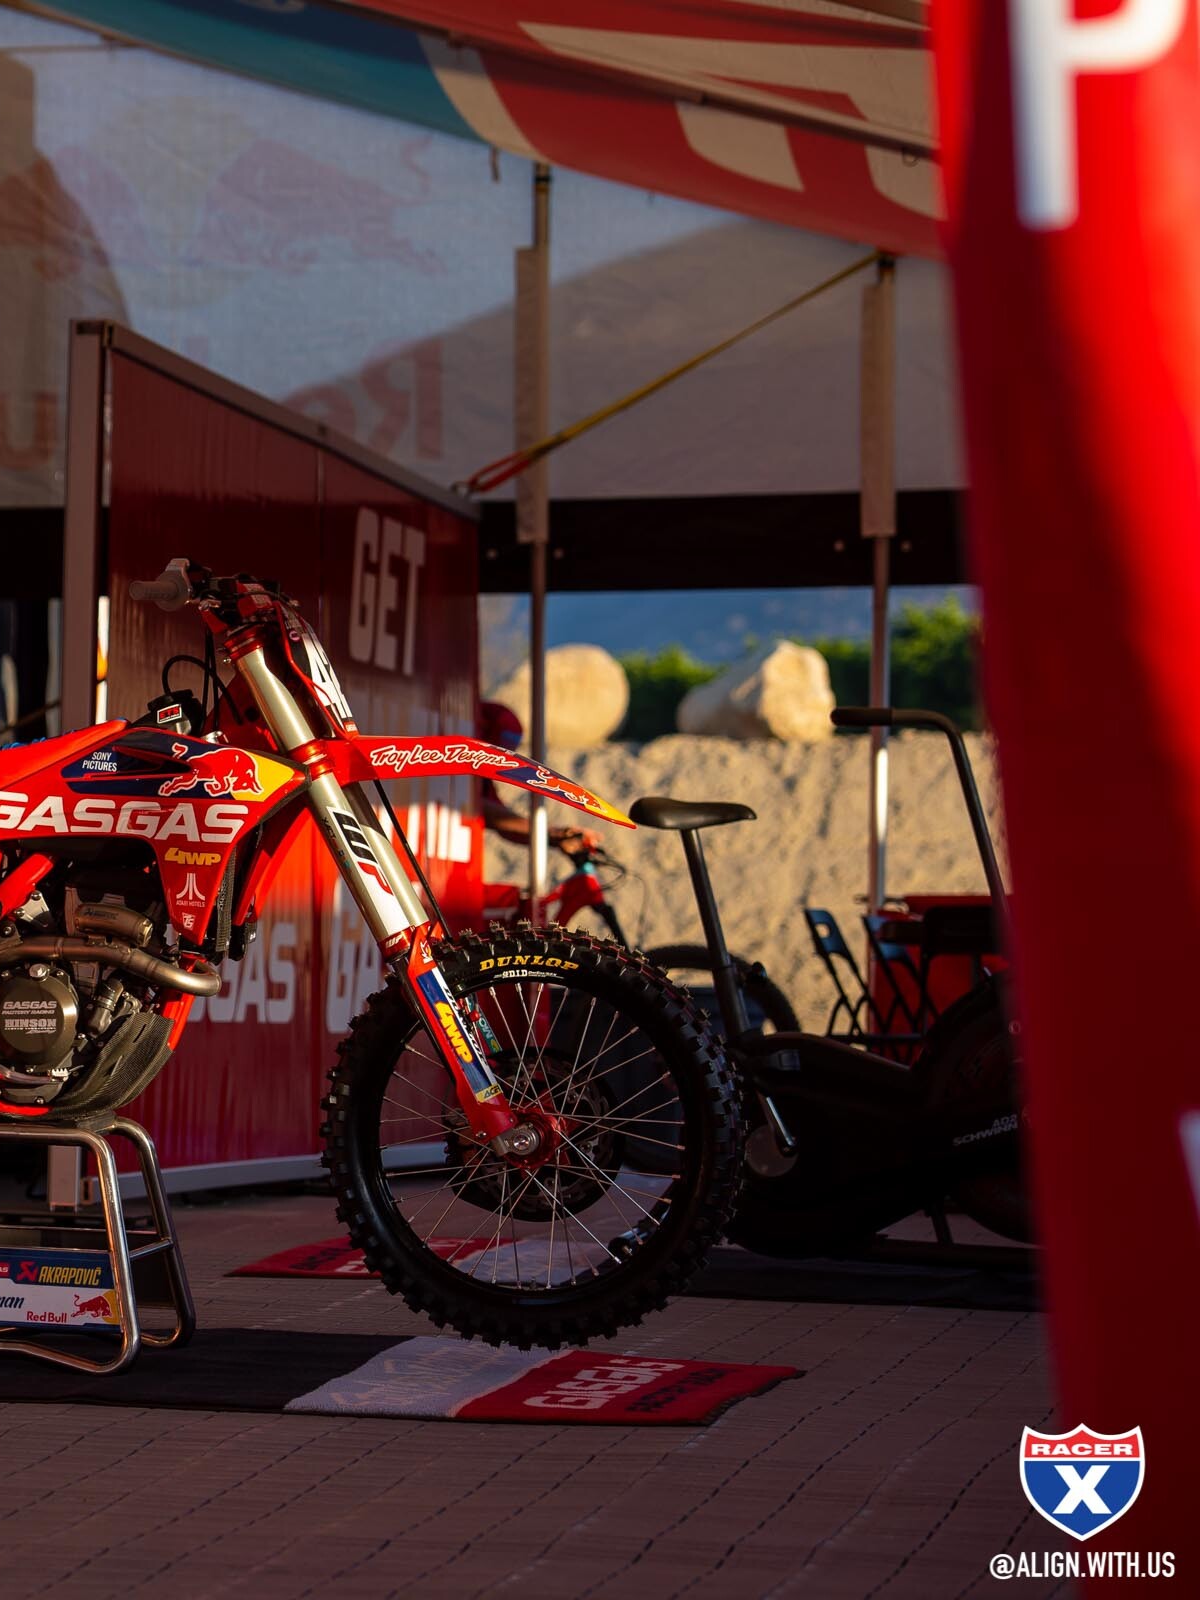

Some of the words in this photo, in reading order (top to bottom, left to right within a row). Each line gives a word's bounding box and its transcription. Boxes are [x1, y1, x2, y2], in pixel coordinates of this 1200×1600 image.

[349, 507, 426, 677] GET
[91, 751, 112, 761] SONY
[370, 745, 410, 773] Troy
[408, 744, 443, 763] Lee
[444, 744, 519, 770] Designs
[82, 759, 118, 773] PICTURES
[479, 955, 580, 971] DUNLOP
[3, 1000, 57, 1010] GASGAS
[4, 1018, 57, 1028] HINSON
[26, 1311, 47, 1322] Red
[48, 1312, 68, 1324] Bull
